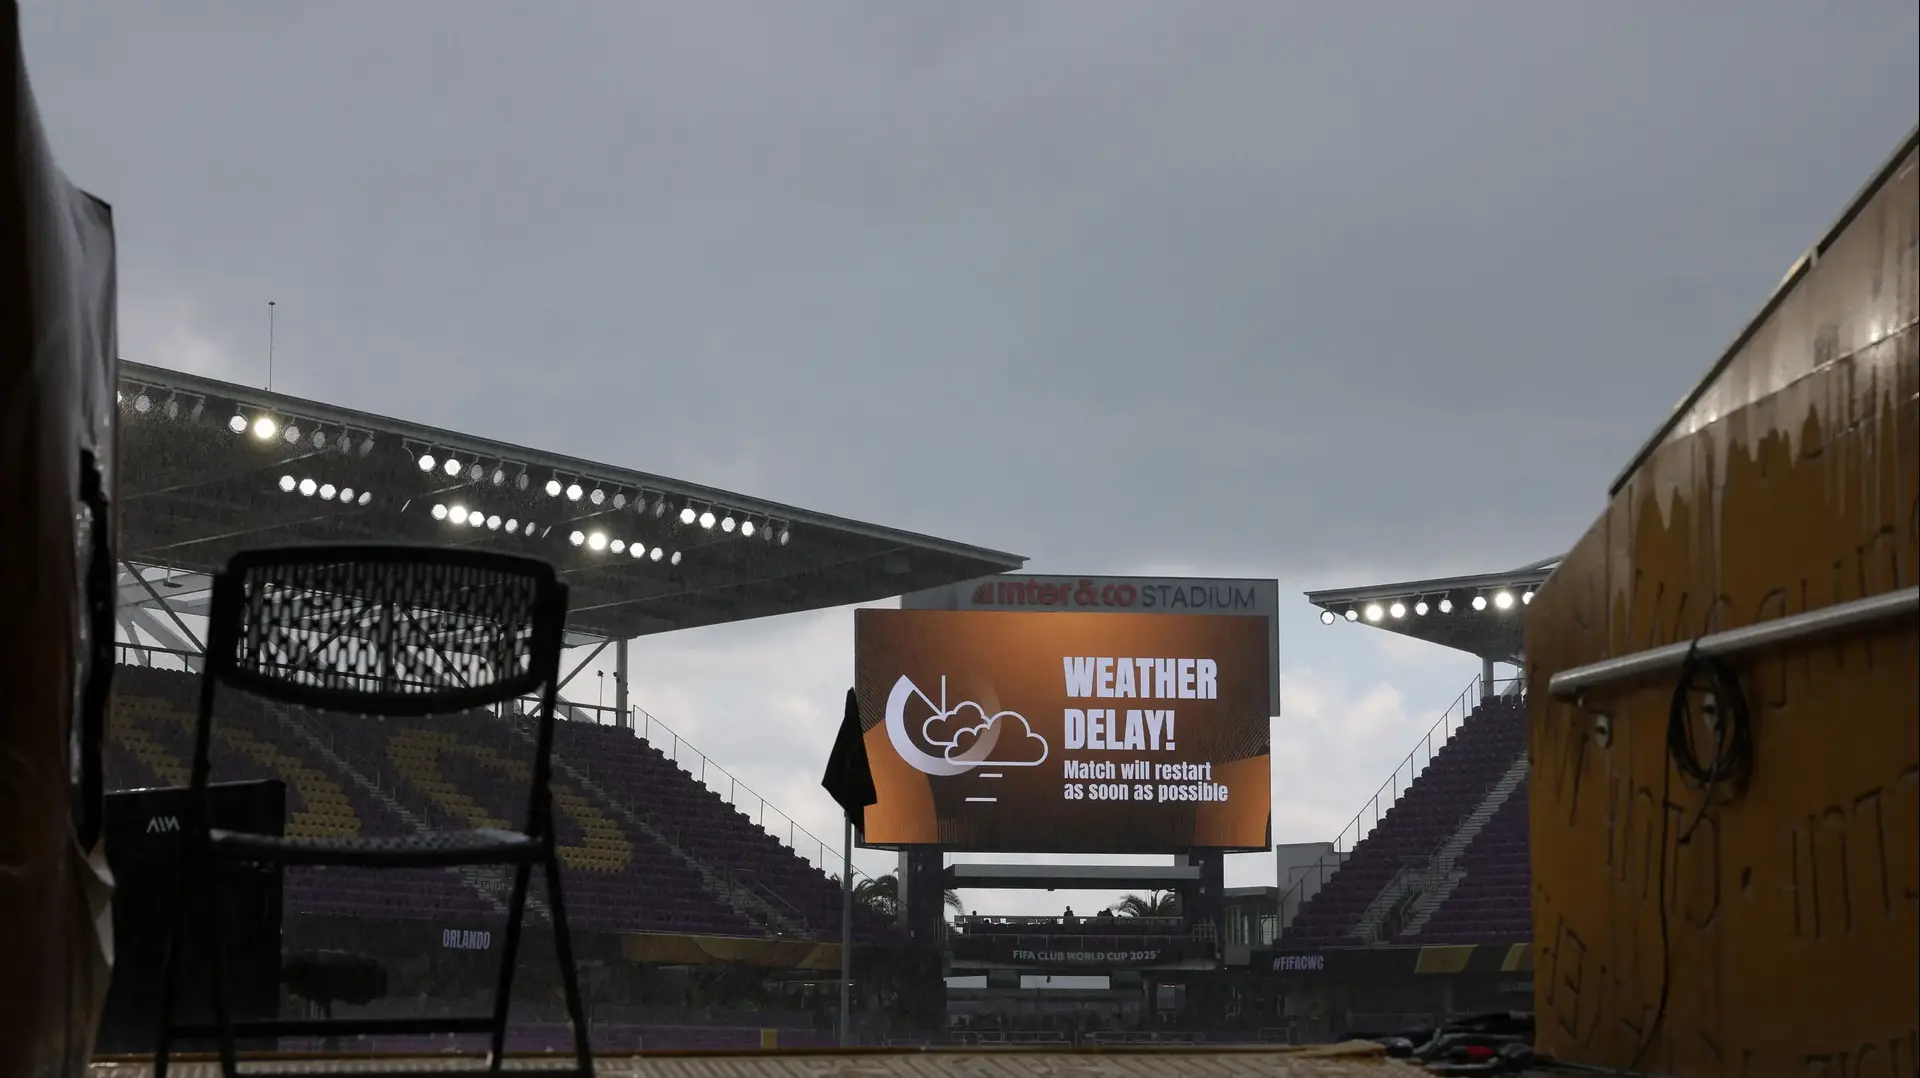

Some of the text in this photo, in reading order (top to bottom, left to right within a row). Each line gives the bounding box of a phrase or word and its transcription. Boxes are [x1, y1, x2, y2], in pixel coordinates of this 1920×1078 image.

[1142, 584, 1256, 610] STADIUM
[1063, 656, 1218, 700] WEATHER
[1064, 708, 1176, 751] DELAY!
[1064, 760, 1212, 781] Match will restart
[1064, 781, 1229, 803] as soon as possible
[442, 928, 491, 950] ORLANDO
[1012, 949, 1036, 959] FIFA
[1037, 949, 1064, 960] CLUB
[1066, 951, 1105, 960] WORLD
[1107, 950, 1128, 960] CUP
[1272, 955, 1325, 972] #FIFACWC
